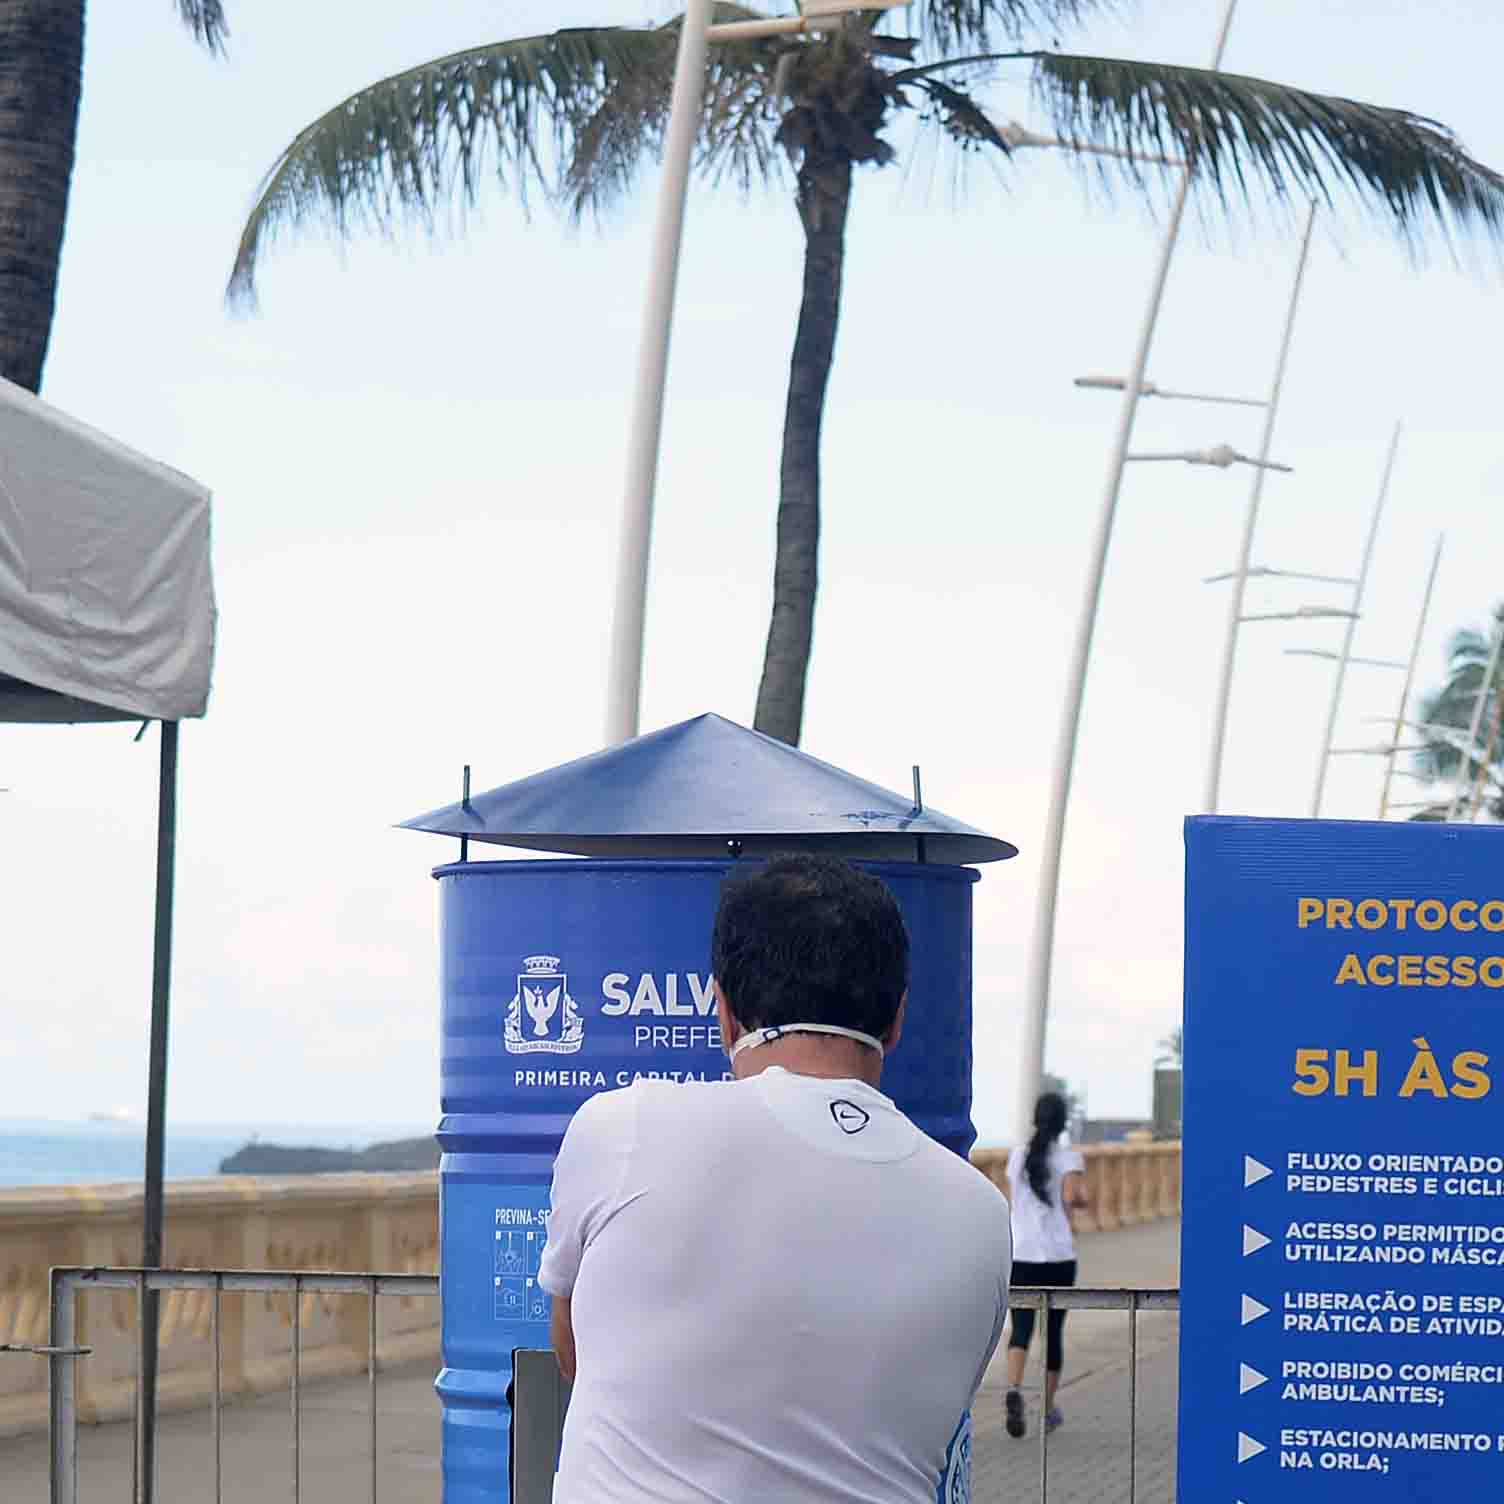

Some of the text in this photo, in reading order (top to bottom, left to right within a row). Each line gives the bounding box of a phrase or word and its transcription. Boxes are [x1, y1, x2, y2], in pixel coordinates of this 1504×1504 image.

[515, 1070, 606, 1087] PRIMEIRA
[1291, 1048, 1378, 1097] 5H
[1398, 1036, 1491, 1100] ÀS
[1287, 1152, 1363, 1171] FLUXO
[1367, 1154, 1504, 1174] ORIENTADO
[1287, 1174, 1418, 1195] PEDESTRES
[1423, 1177, 1438, 1195] E
[1285, 1221, 1377, 1241] ACESSO
[1285, 1243, 1426, 1264] UTILIZANDO
[1284, 1289, 1417, 1314] LIBERAÇÃO
[1422, 1295, 1454, 1313] DE
[1283, 1310, 1384, 1333] PRÁTICA
[1389, 1316, 1421, 1334] DE
[1282, 1360, 1393, 1381] PROIBIDO
[1281, 1383, 1445, 1408] AMBULANTES;
[1280, 1429, 1492, 1451] ESTACIONAMENTO
[1280, 1450, 1389, 1474] NA ORLA;
